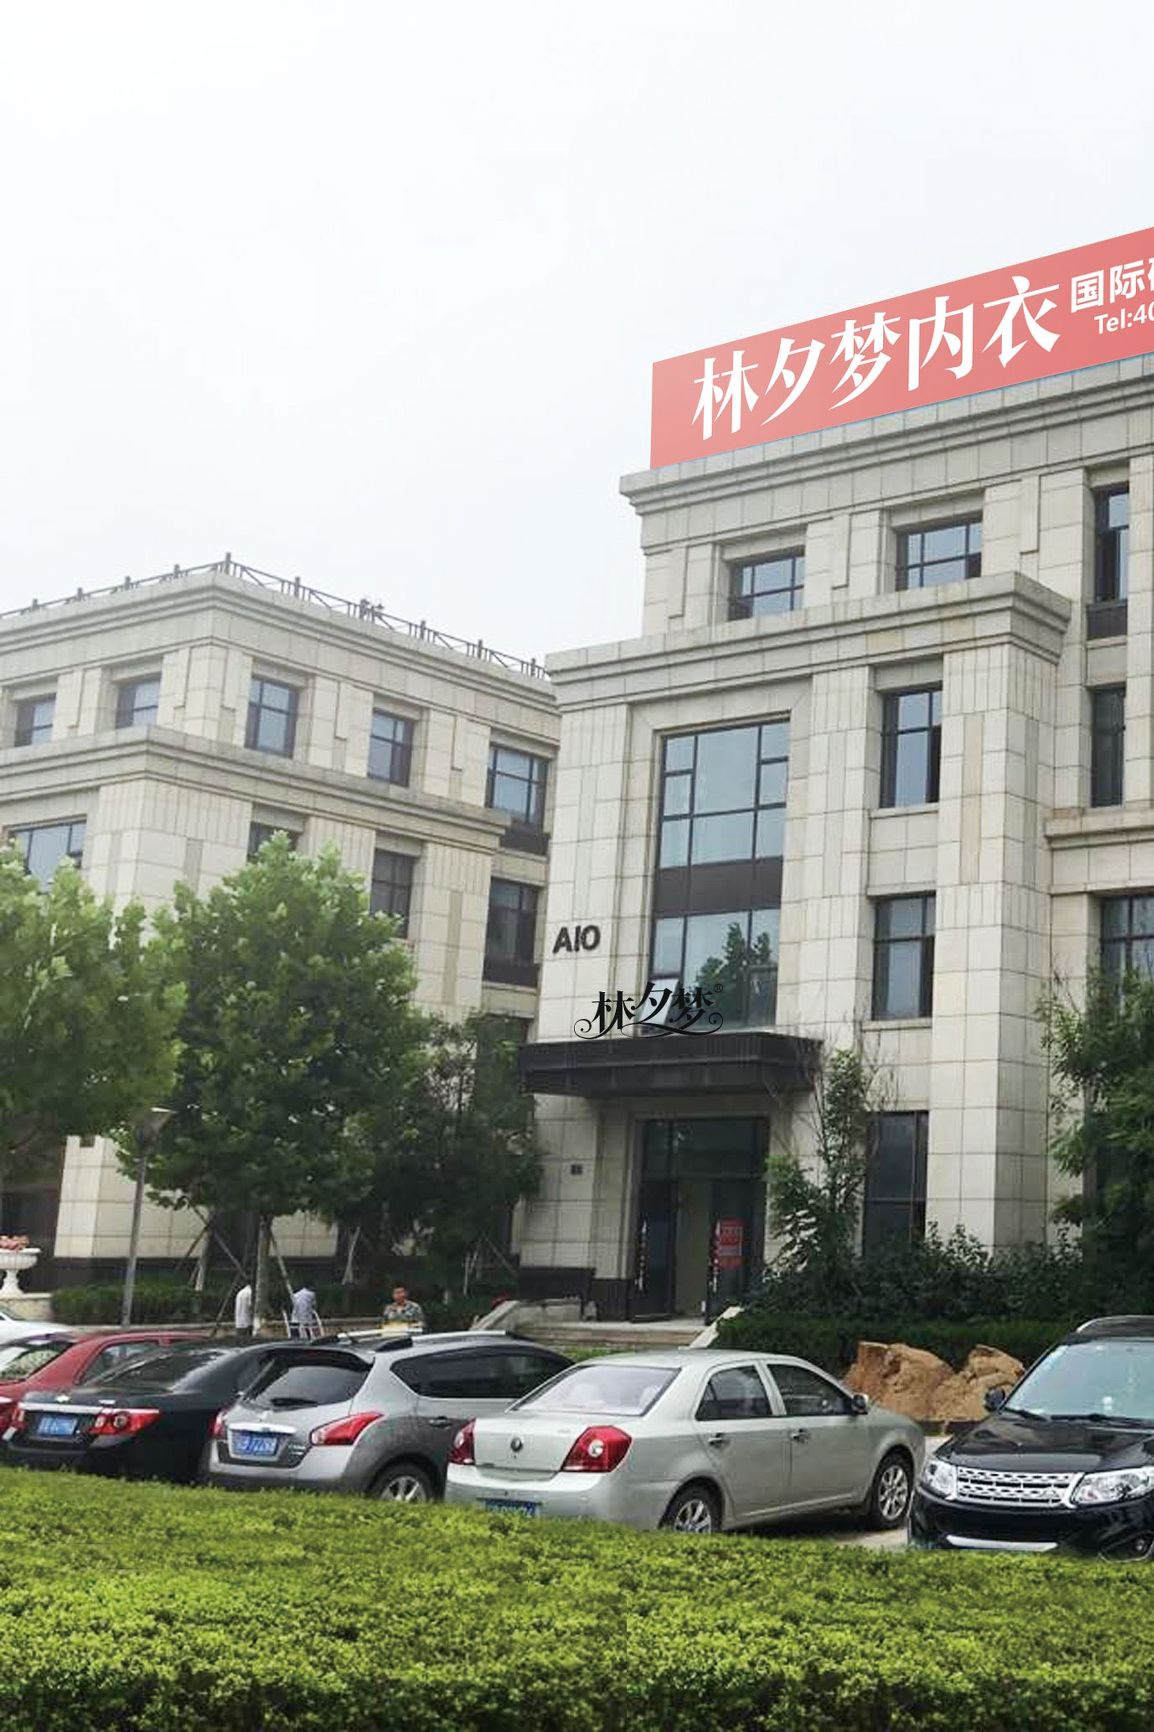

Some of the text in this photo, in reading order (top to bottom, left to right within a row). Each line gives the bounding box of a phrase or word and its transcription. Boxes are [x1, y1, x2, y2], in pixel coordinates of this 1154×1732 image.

[692, 275, 1061, 441] 林夕梦内衣
[573, 981, 724, 1040] 林夕梦
